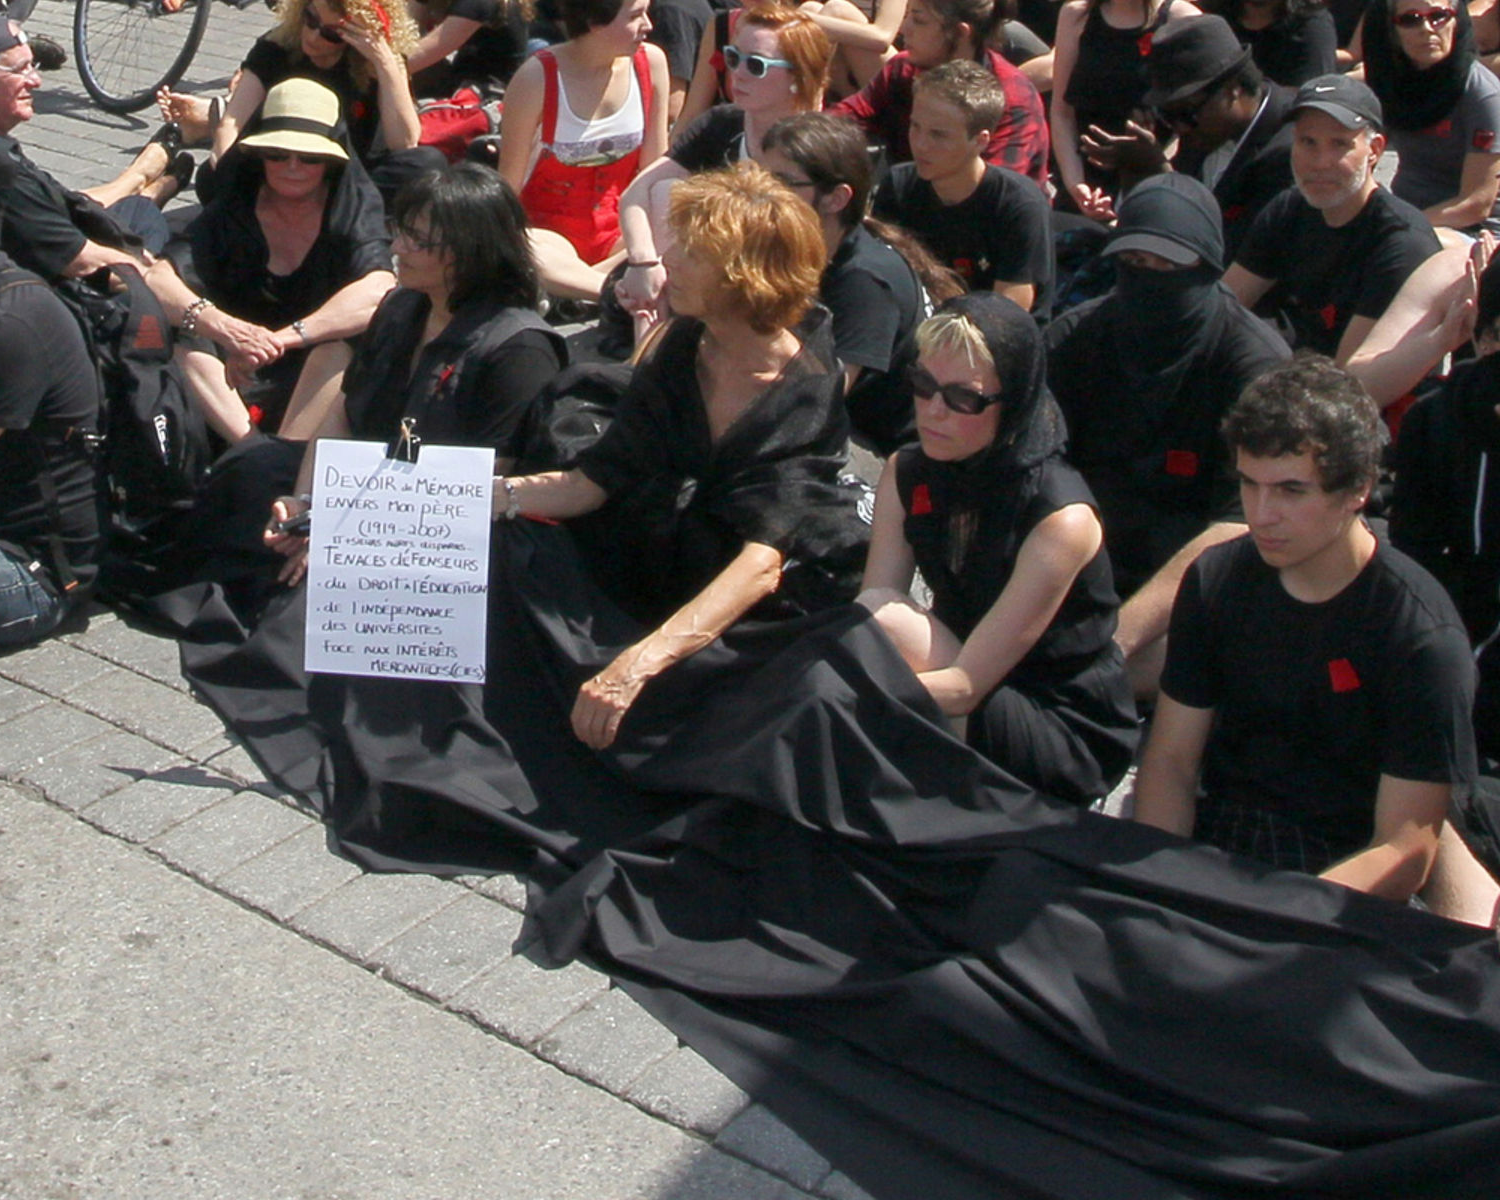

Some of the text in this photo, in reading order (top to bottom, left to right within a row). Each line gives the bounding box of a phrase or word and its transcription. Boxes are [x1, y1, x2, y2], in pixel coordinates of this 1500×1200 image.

[325, 465, 396, 491] DEVOIR
[325, 497, 378, 509] ENVERS
[324, 545, 387, 567] TENACES
